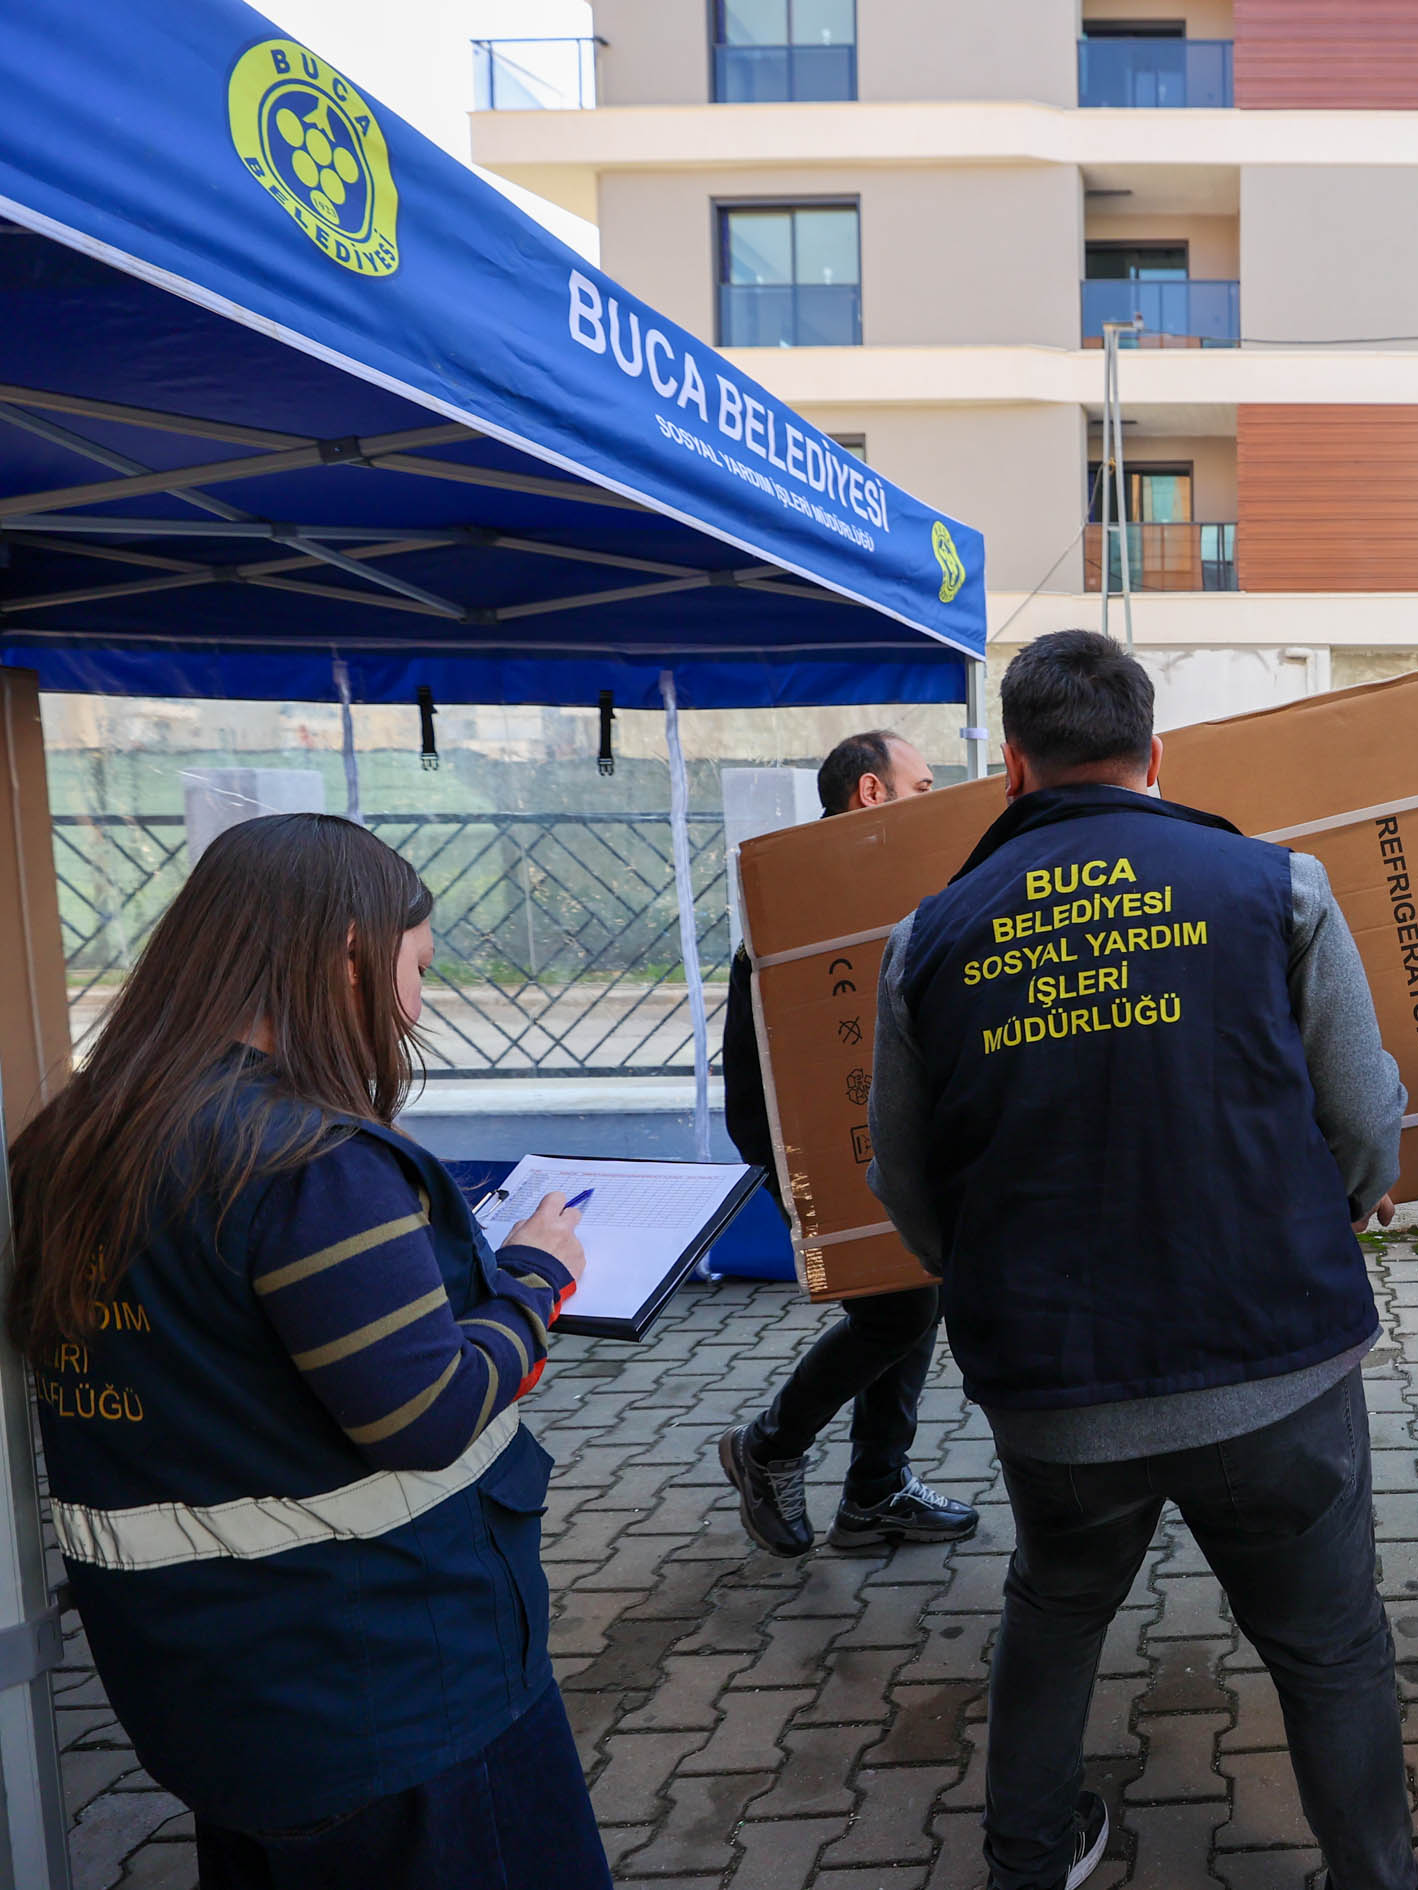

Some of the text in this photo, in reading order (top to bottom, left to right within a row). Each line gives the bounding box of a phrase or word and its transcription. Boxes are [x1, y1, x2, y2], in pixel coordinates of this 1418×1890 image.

[271, 49, 371, 137] BUCA
[568, 268, 890, 533] BUCA BELEDİYESİ
[655, 413, 875, 553] SOSYAL YARDIM İŞLERİ MÜDÜRLÜĞÜ
[1026, 858, 1137, 900] BUCA
[992, 886, 1172, 943] BELEDİYESİ
[963, 921, 1208, 986] SOSYAL YARDIM
[1028, 960, 1128, 1008] İŞLERİ
[982, 993, 1182, 1055] MÜDÜRLÜĞÜ
